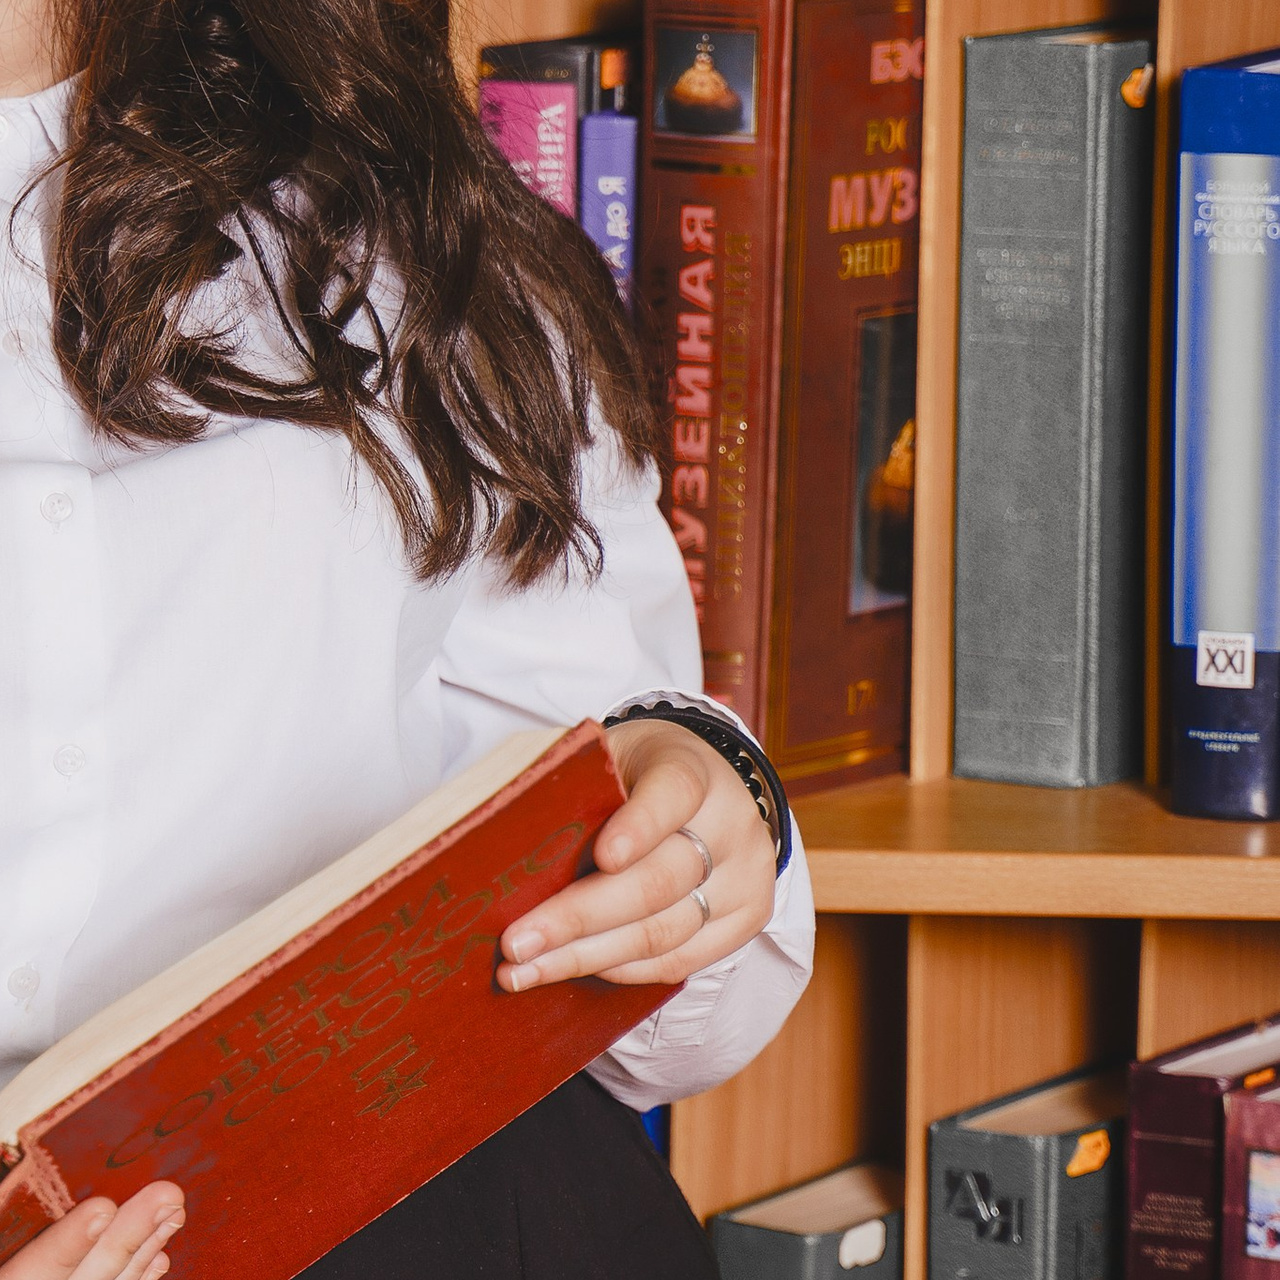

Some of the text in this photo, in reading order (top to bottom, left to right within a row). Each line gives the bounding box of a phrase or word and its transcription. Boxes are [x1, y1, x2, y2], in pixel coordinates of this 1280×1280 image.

[1198, 202, 1278, 222] СЛОВАРЬ
[105, 821, 587, 1170] СОВЕТСКОГО
[212, 873, 459, 1064] ГЕРОИ
